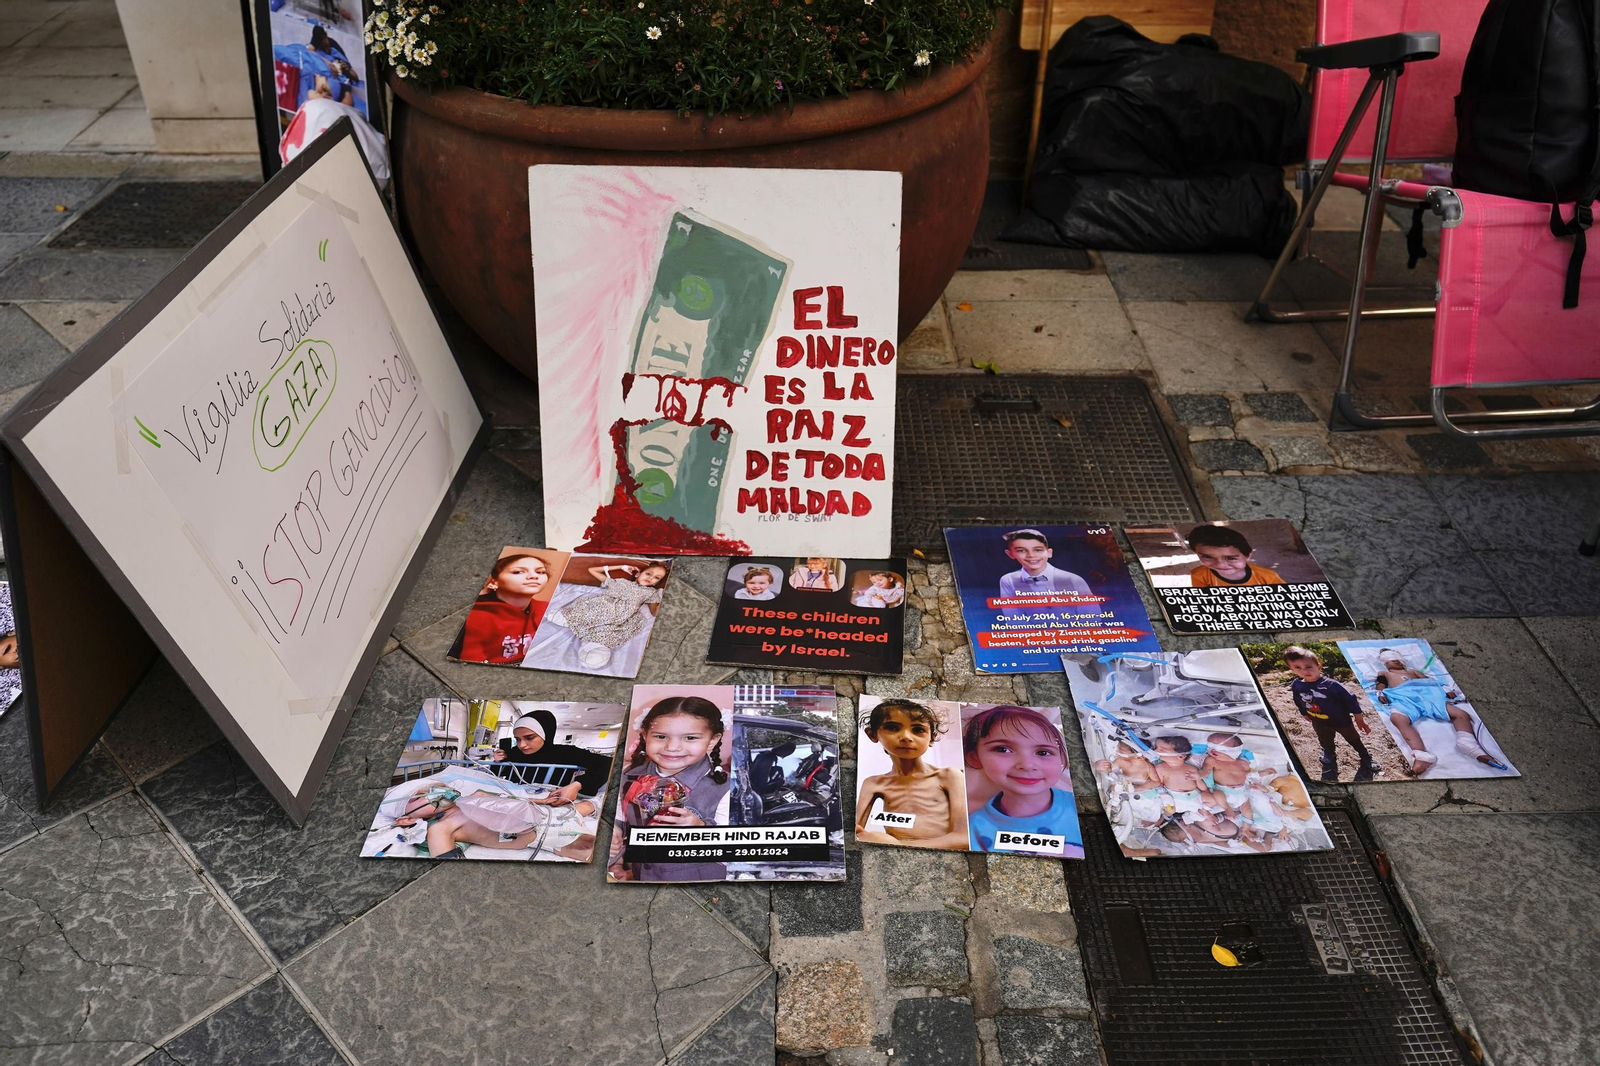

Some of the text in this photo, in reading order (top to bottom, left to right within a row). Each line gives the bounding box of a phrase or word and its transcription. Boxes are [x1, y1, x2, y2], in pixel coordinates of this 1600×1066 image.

[792, 285, 858, 330] EL
[776, 334, 895, 369] DINERO
[764, 375, 807, 405] ES
[260, 347, 330, 448] GAZA
[766, 408, 873, 448] RAIZ
[707, 456, 723, 488] ONE
[736, 486, 873, 517] MALDAD
[788, 514, 800, 522] DE
[1014, 588, 1079, 597] Remembering
[1159, 582, 1330, 596] ISRAEL DROPPED A BOMB
[992, 596, 1049, 606] Mohammad
[1165, 591, 1332, 605] ON LITTLE ABOUD WHILE
[1180, 600, 1326, 613] HE WAS WAITING FOR
[742, 606, 880, 626] These children
[996, 611, 1115, 622] On July 2014, 16-year-old
[1173, 608, 1339, 624] FOOD, ABOUD WAS ONLY
[728, 623, 777, 636] were
[991, 621, 1048, 630] Mohammad
[1070, 620, 1103, 628] Khdair
[1195, 618, 1328, 631] THREE YEARS OLD.
[990, 630, 1043, 639] kidnapped
[1043, 630, 1057, 638] by
[1057, 628, 1090, 636] Zionist
[987, 640, 1026, 648] beaten,
[1026, 638, 1058, 646] forced
[1098, 636, 1138, 644] gasoline
[761, 641, 851, 658] by Israel.
[1022, 646, 1042, 654] and
[1042, 645, 1079, 654] burned
[874, 812, 913, 824] After
[636, 830, 821, 842] REMEMBER HIND RAJAB
[999, 833, 1061, 848] Before
[667, 848, 724, 858] 03.05.2018
[734, 848, 790, 857] 29.01.2024
